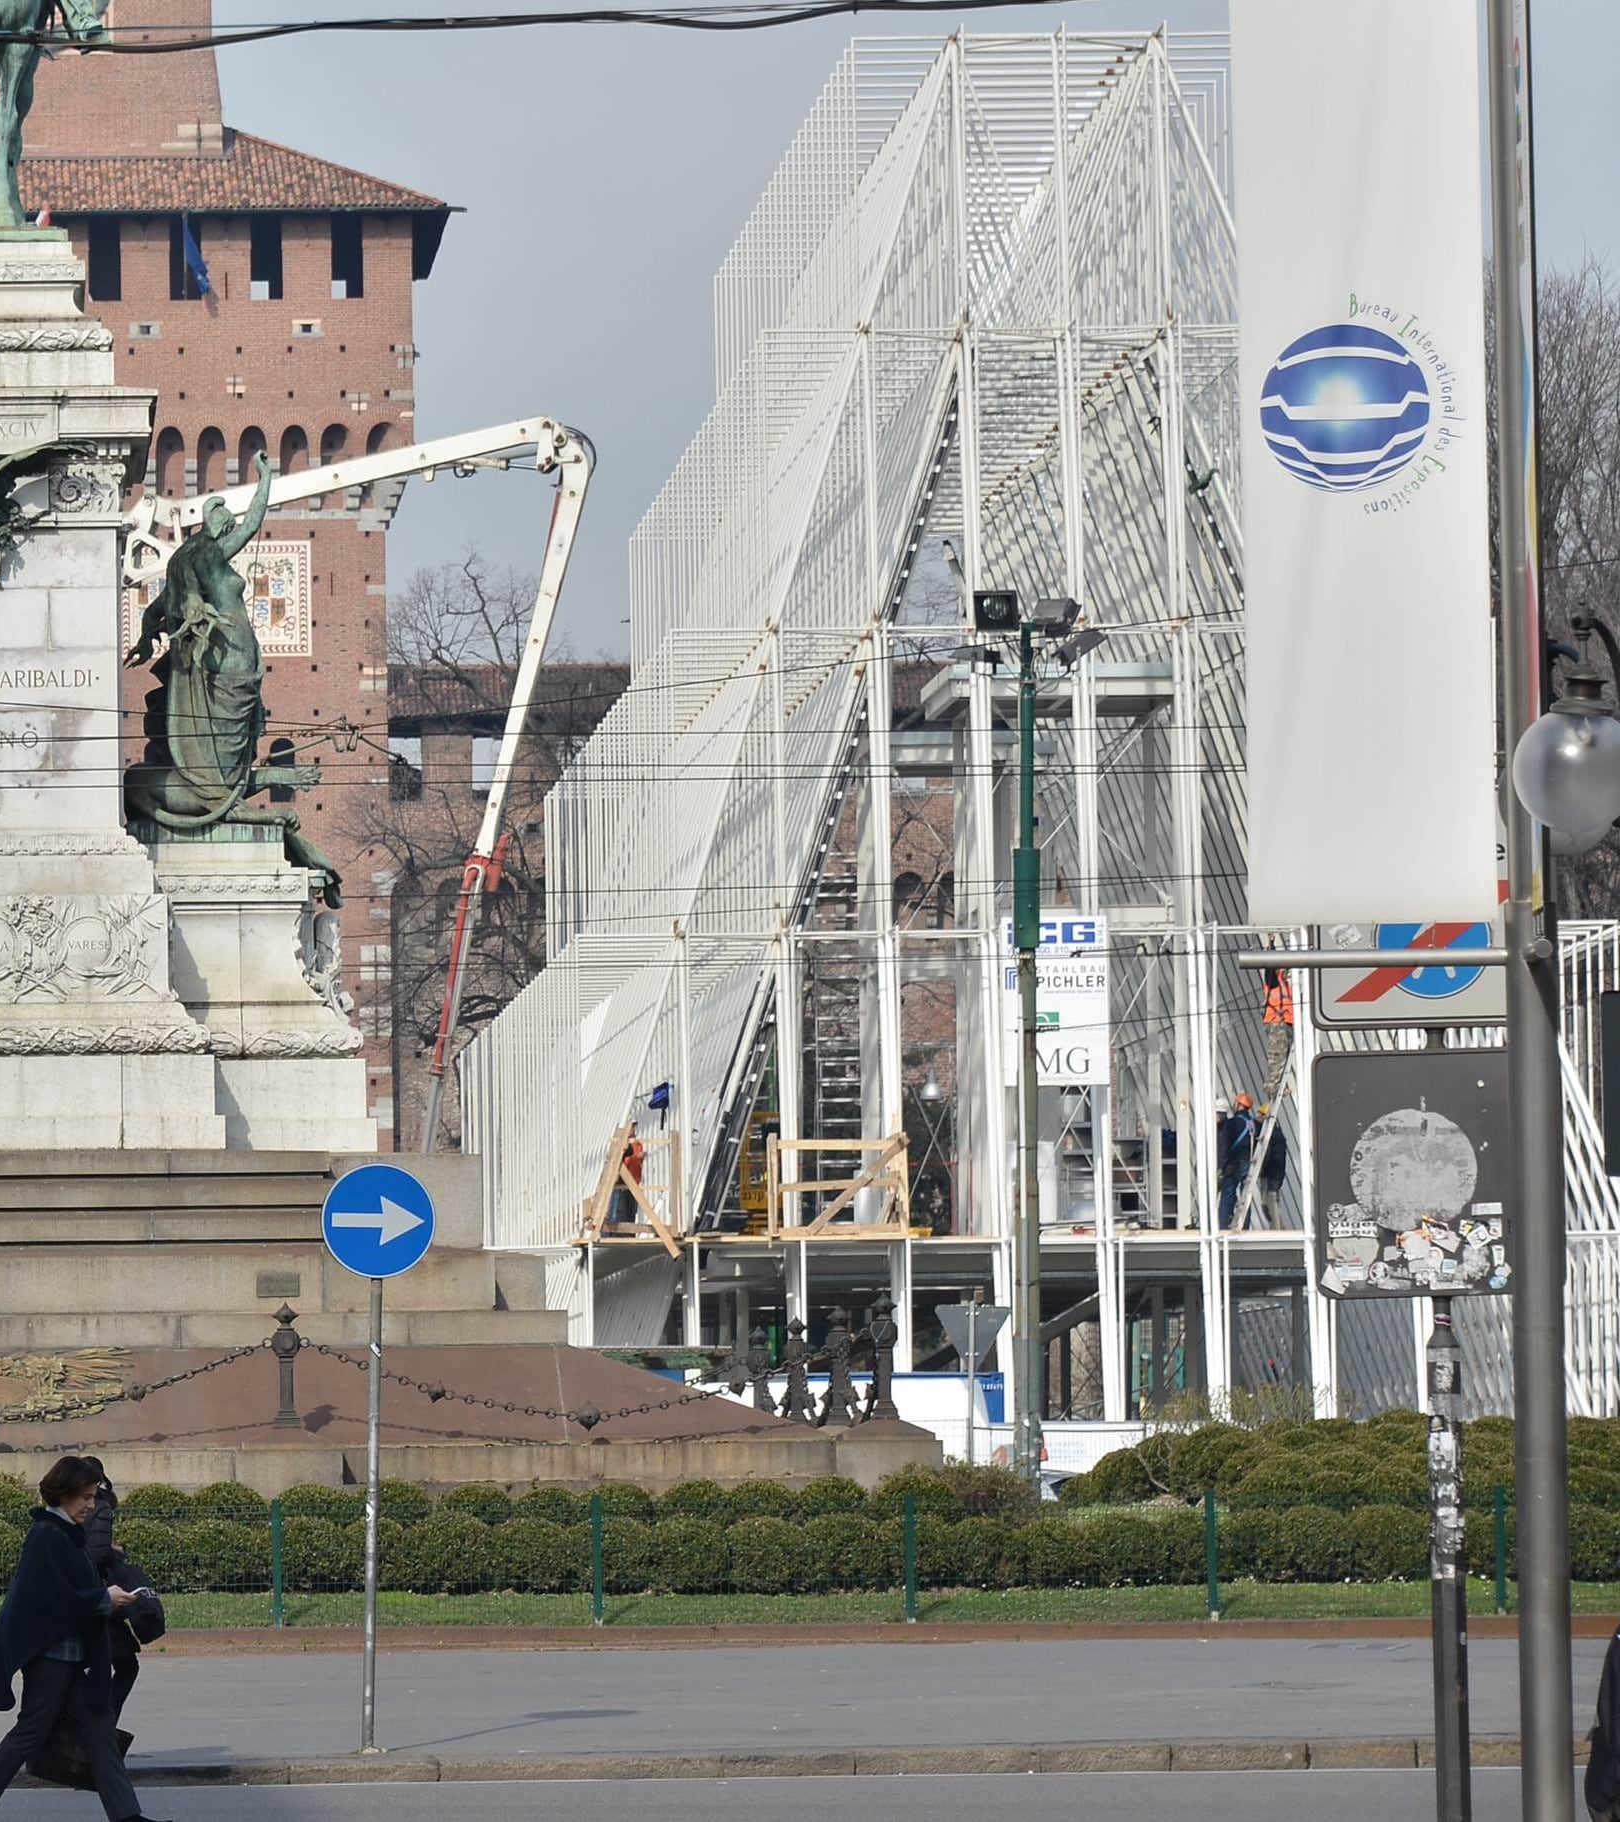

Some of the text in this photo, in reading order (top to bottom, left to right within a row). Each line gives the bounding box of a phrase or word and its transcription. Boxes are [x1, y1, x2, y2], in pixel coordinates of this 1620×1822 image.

[1349, 292, 1467, 516] Bureau International des Expositions
[66, 939, 111, 951] VARESE
[1036, 965, 1106, 974] STAHLBAU
[1036, 975, 1106, 988] PICHLER
